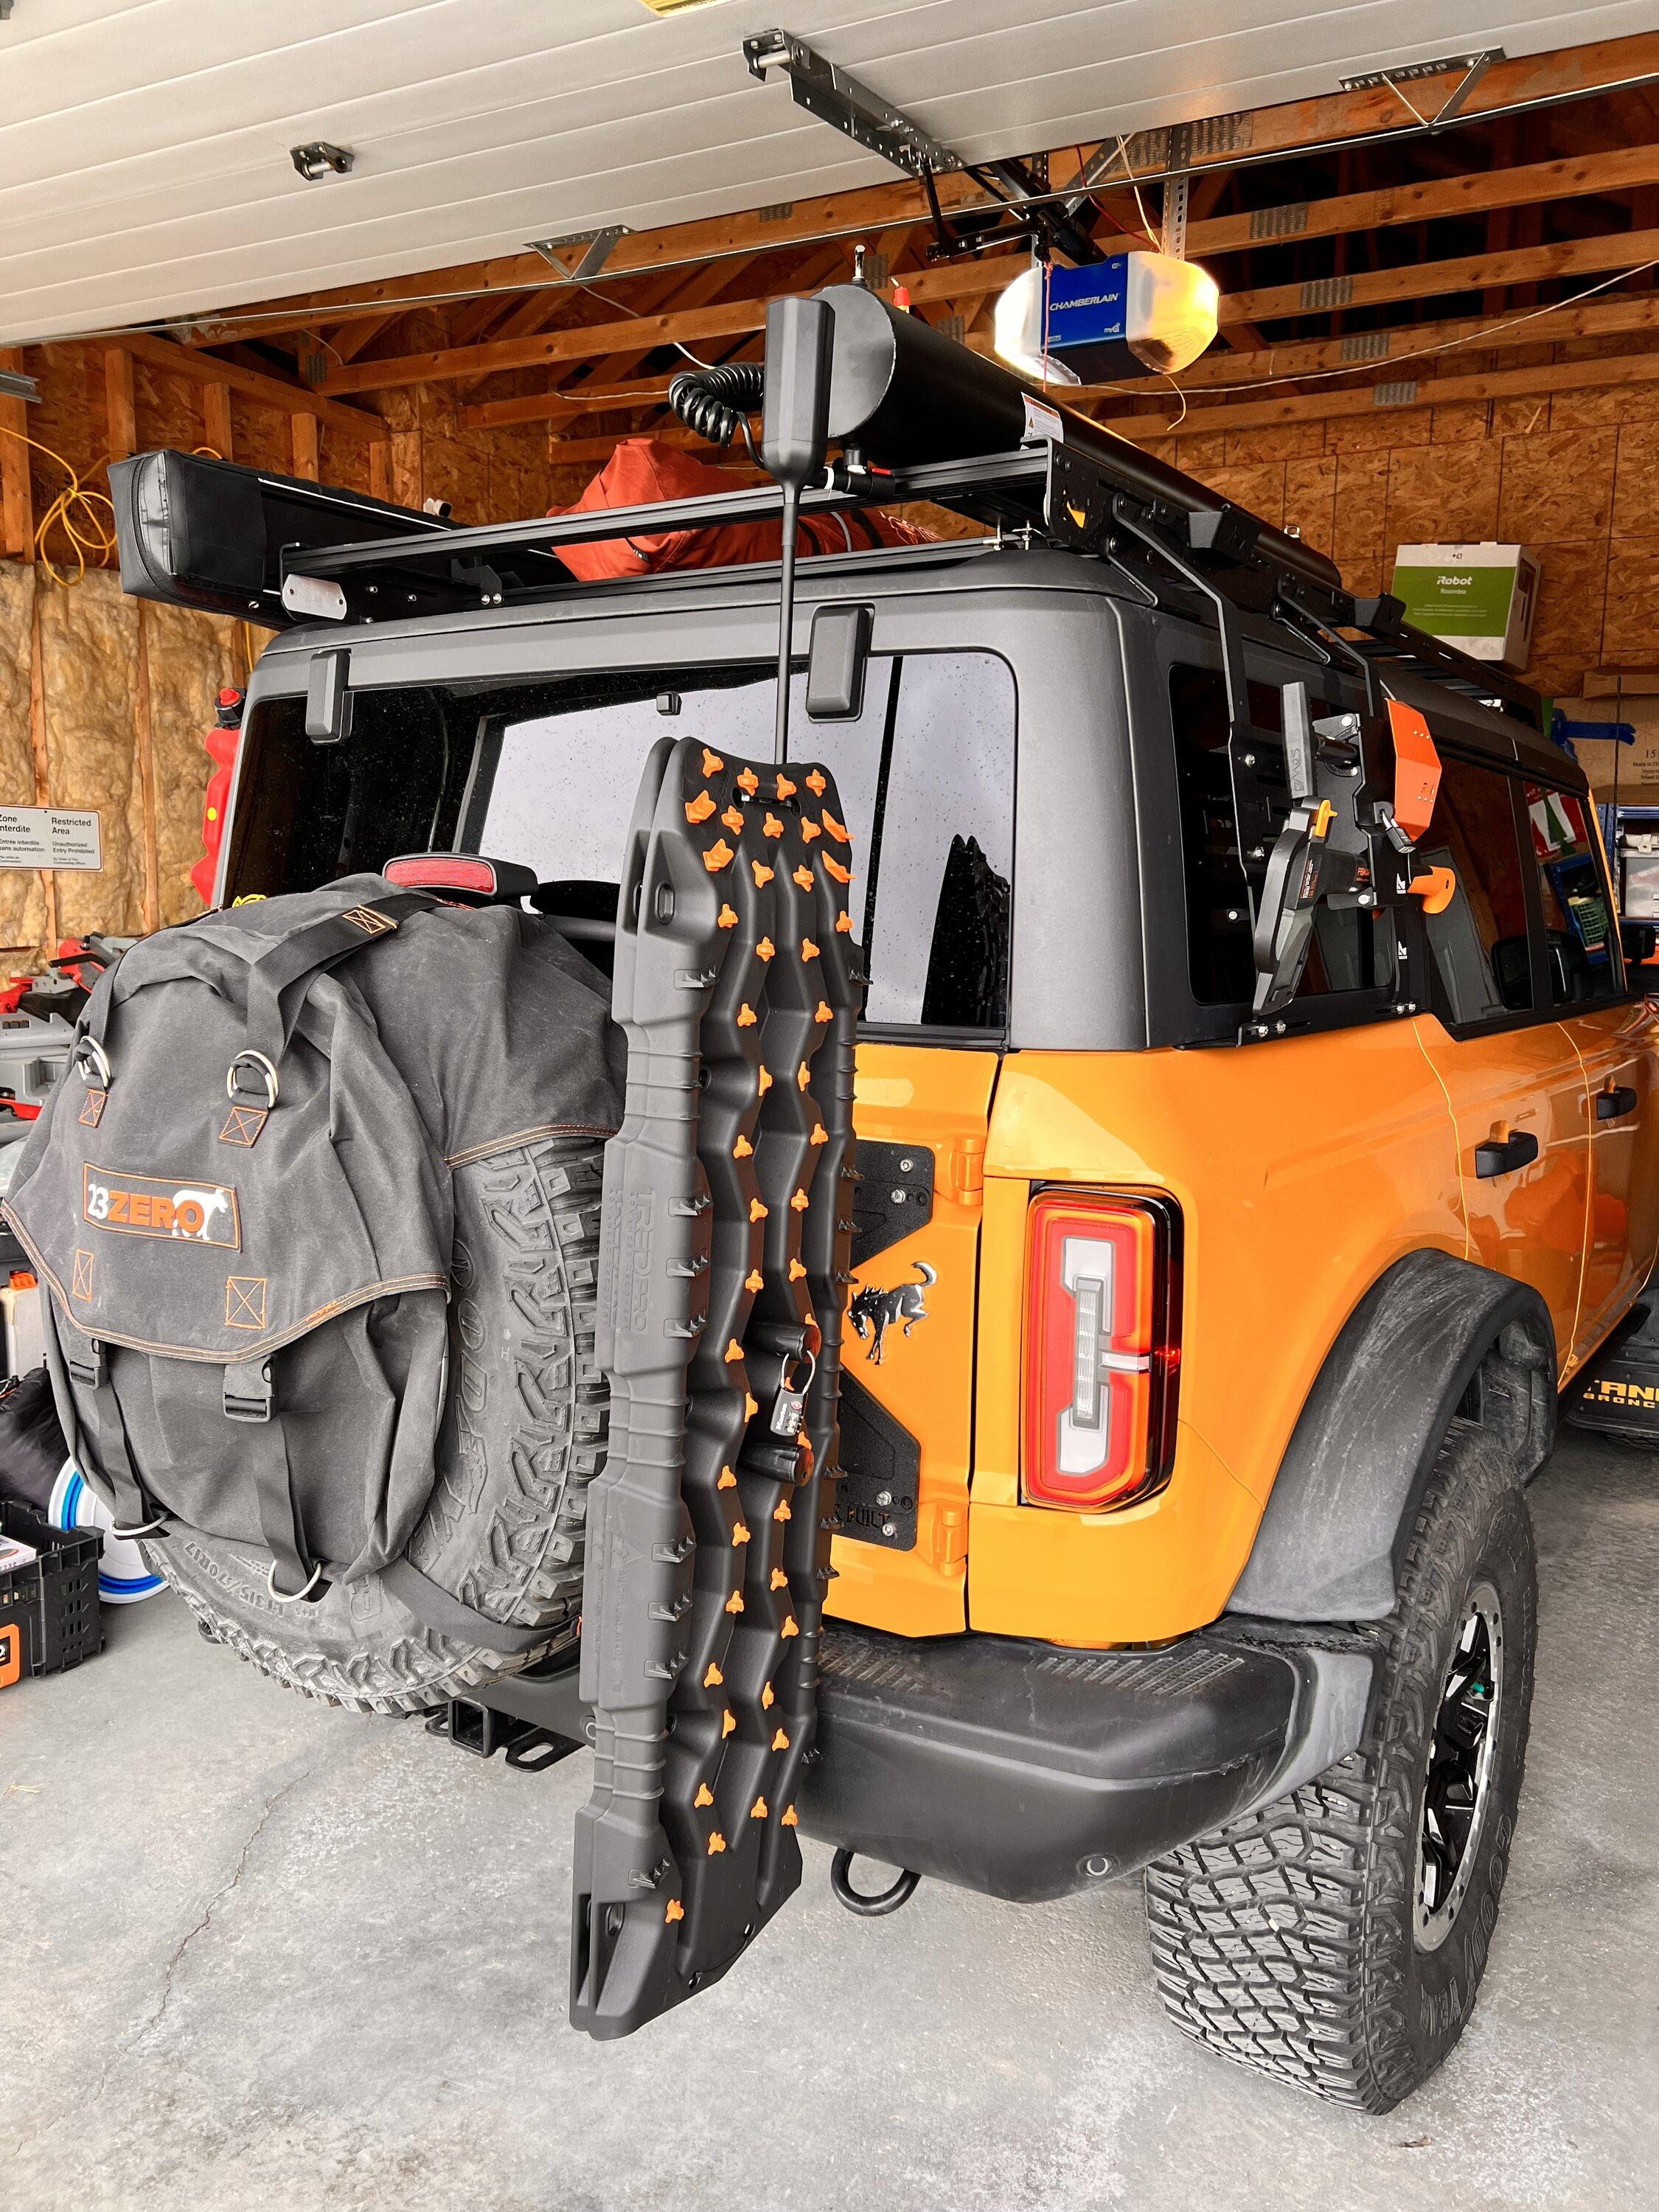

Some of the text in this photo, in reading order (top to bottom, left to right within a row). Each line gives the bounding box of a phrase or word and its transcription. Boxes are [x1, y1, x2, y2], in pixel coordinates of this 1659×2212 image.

[1049, 293, 1119, 310] CHAMBERLAIN
[52, 817, 91, 827] Restricted
[0, 824, 31, 833] nterdite
[52, 827, 70, 835] Area
[88, 1183, 205, 1233] 23ZERO
